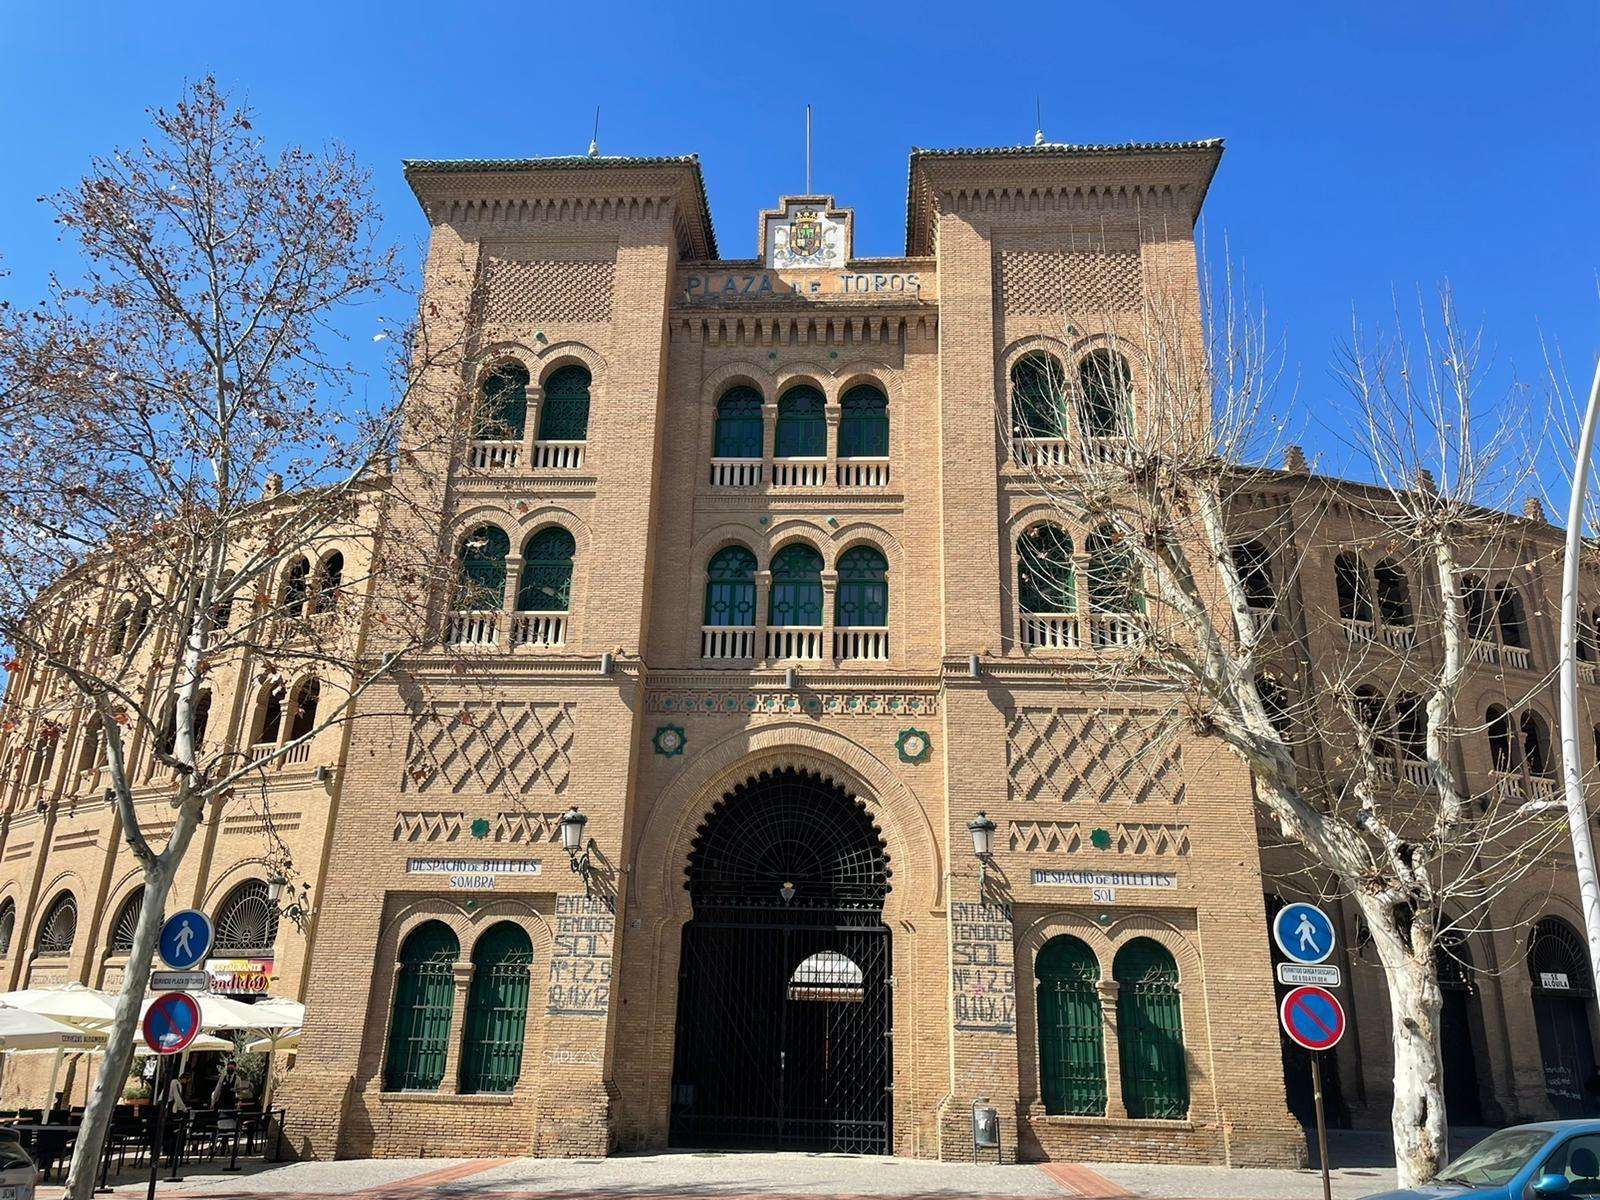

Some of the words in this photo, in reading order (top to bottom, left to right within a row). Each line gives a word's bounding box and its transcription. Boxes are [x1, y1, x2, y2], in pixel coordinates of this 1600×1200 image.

[687, 275, 773, 295] PLAZA
[841, 274, 919, 293] TOROS
[412, 860, 466, 871] DESPACHO
[483, 860, 537, 872] BILLETES
[449, 875, 495, 888] SOMBRA
[1036, 870, 1093, 884] DESPACHO
[1112, 873, 1171, 887] BILLETES
[1093, 889, 1114, 902] SOL
[951, 924, 1013, 941] TENDIDOS
[553, 934, 611, 958] SOL
[952, 943, 1013, 966] SOL
